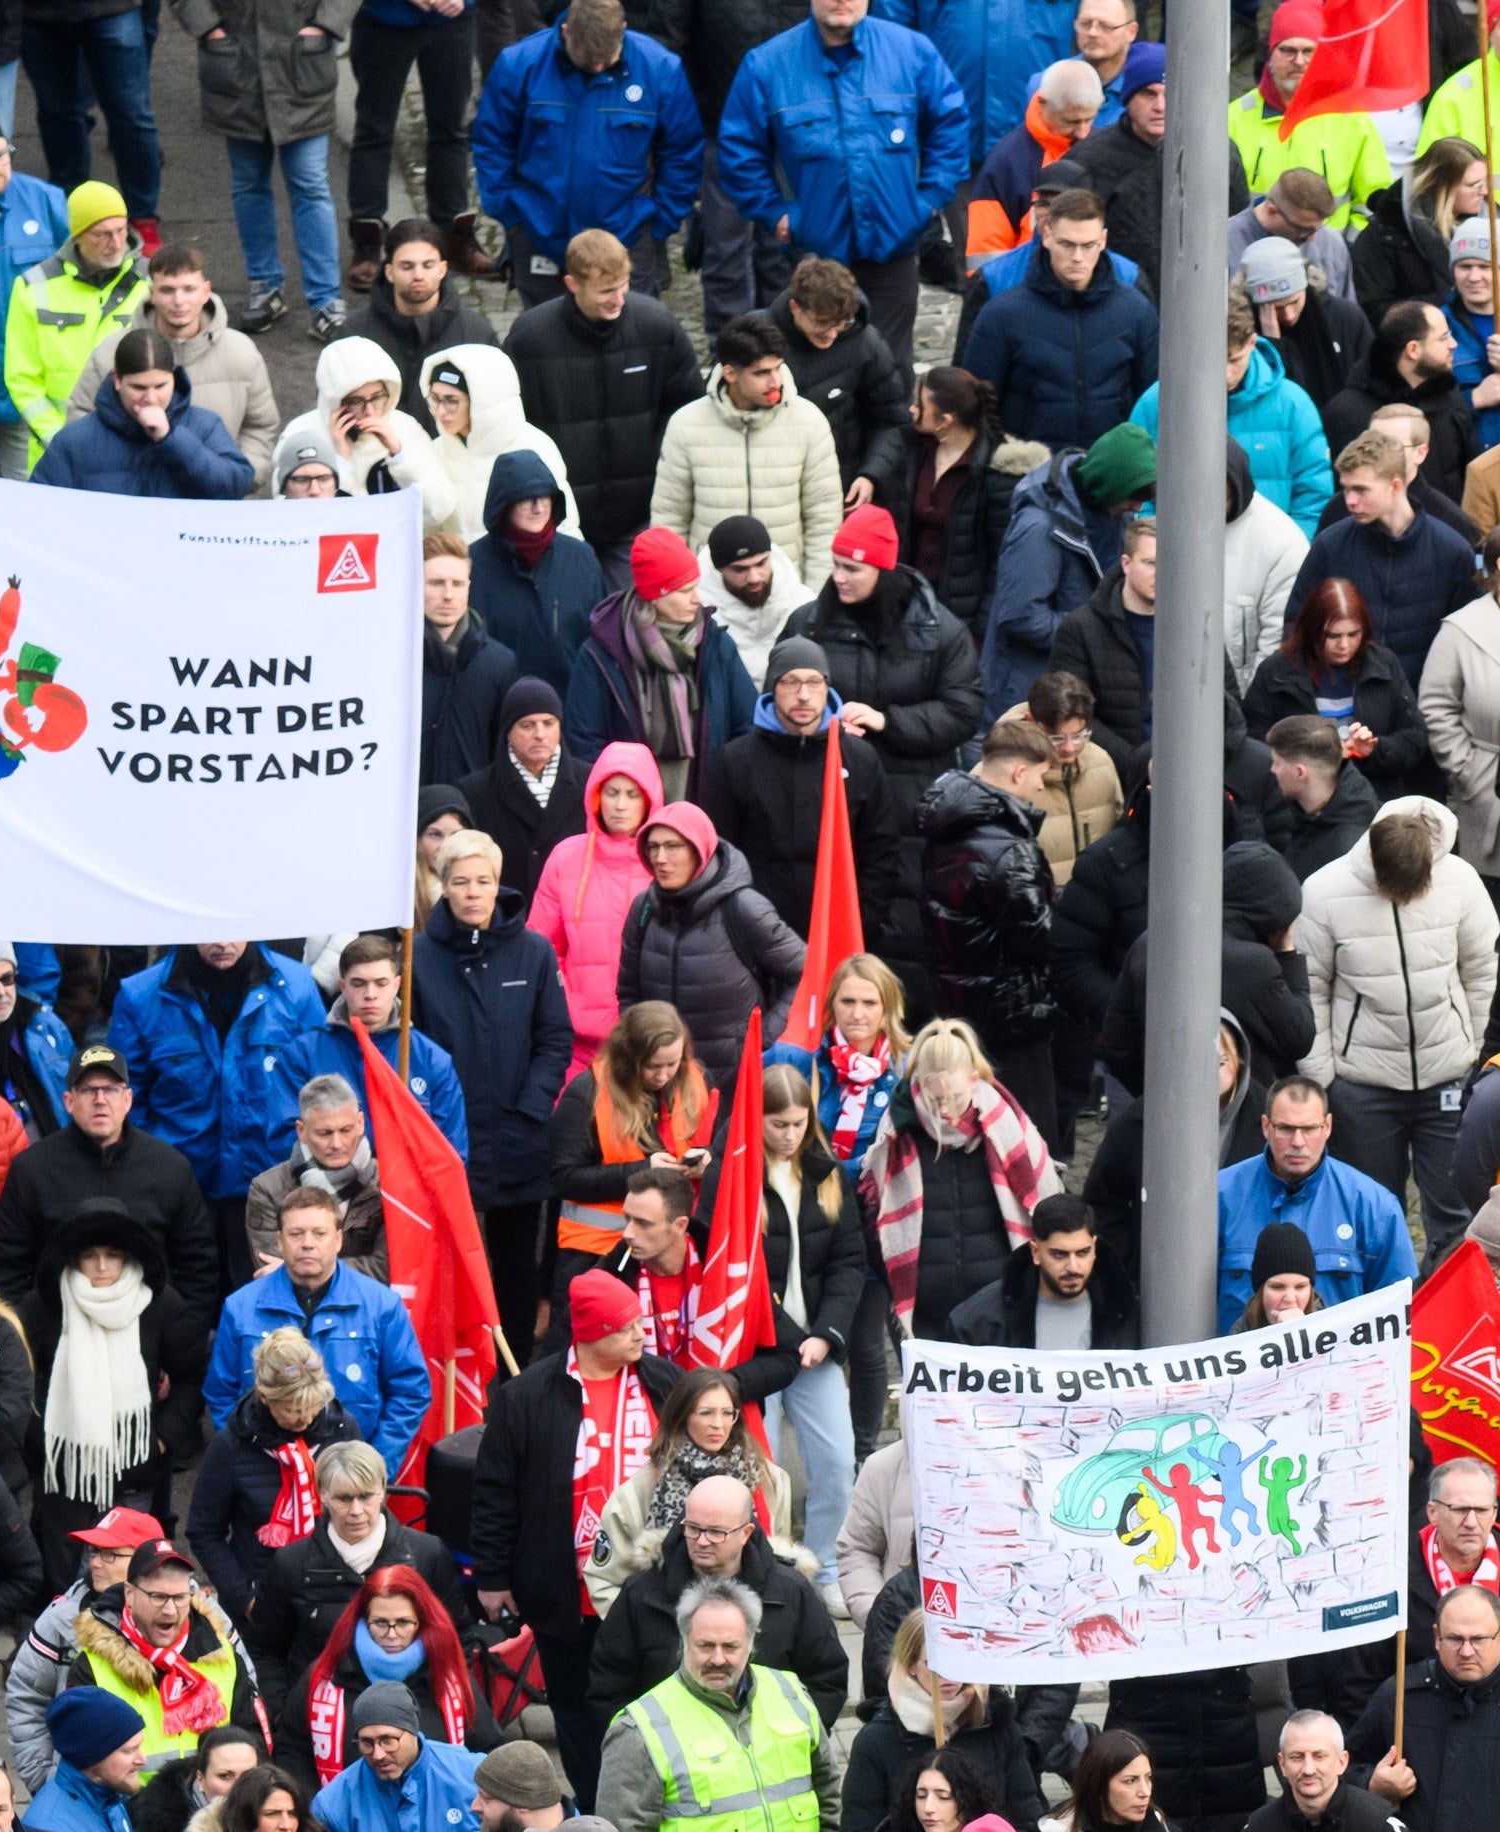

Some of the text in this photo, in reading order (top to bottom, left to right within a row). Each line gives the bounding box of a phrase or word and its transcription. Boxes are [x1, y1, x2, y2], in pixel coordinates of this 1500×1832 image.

[178, 532, 311, 547] Kunststofftechnik
[169, 655, 313, 689] WANN
[111, 697, 364, 736] SPART DER
[96, 742, 379, 784] VORSTAND?
[905, 1305, 1412, 1401] Arbeit geht uns alle an!
[1339, 1601, 1388, 1616] VOLKSWAGEN
